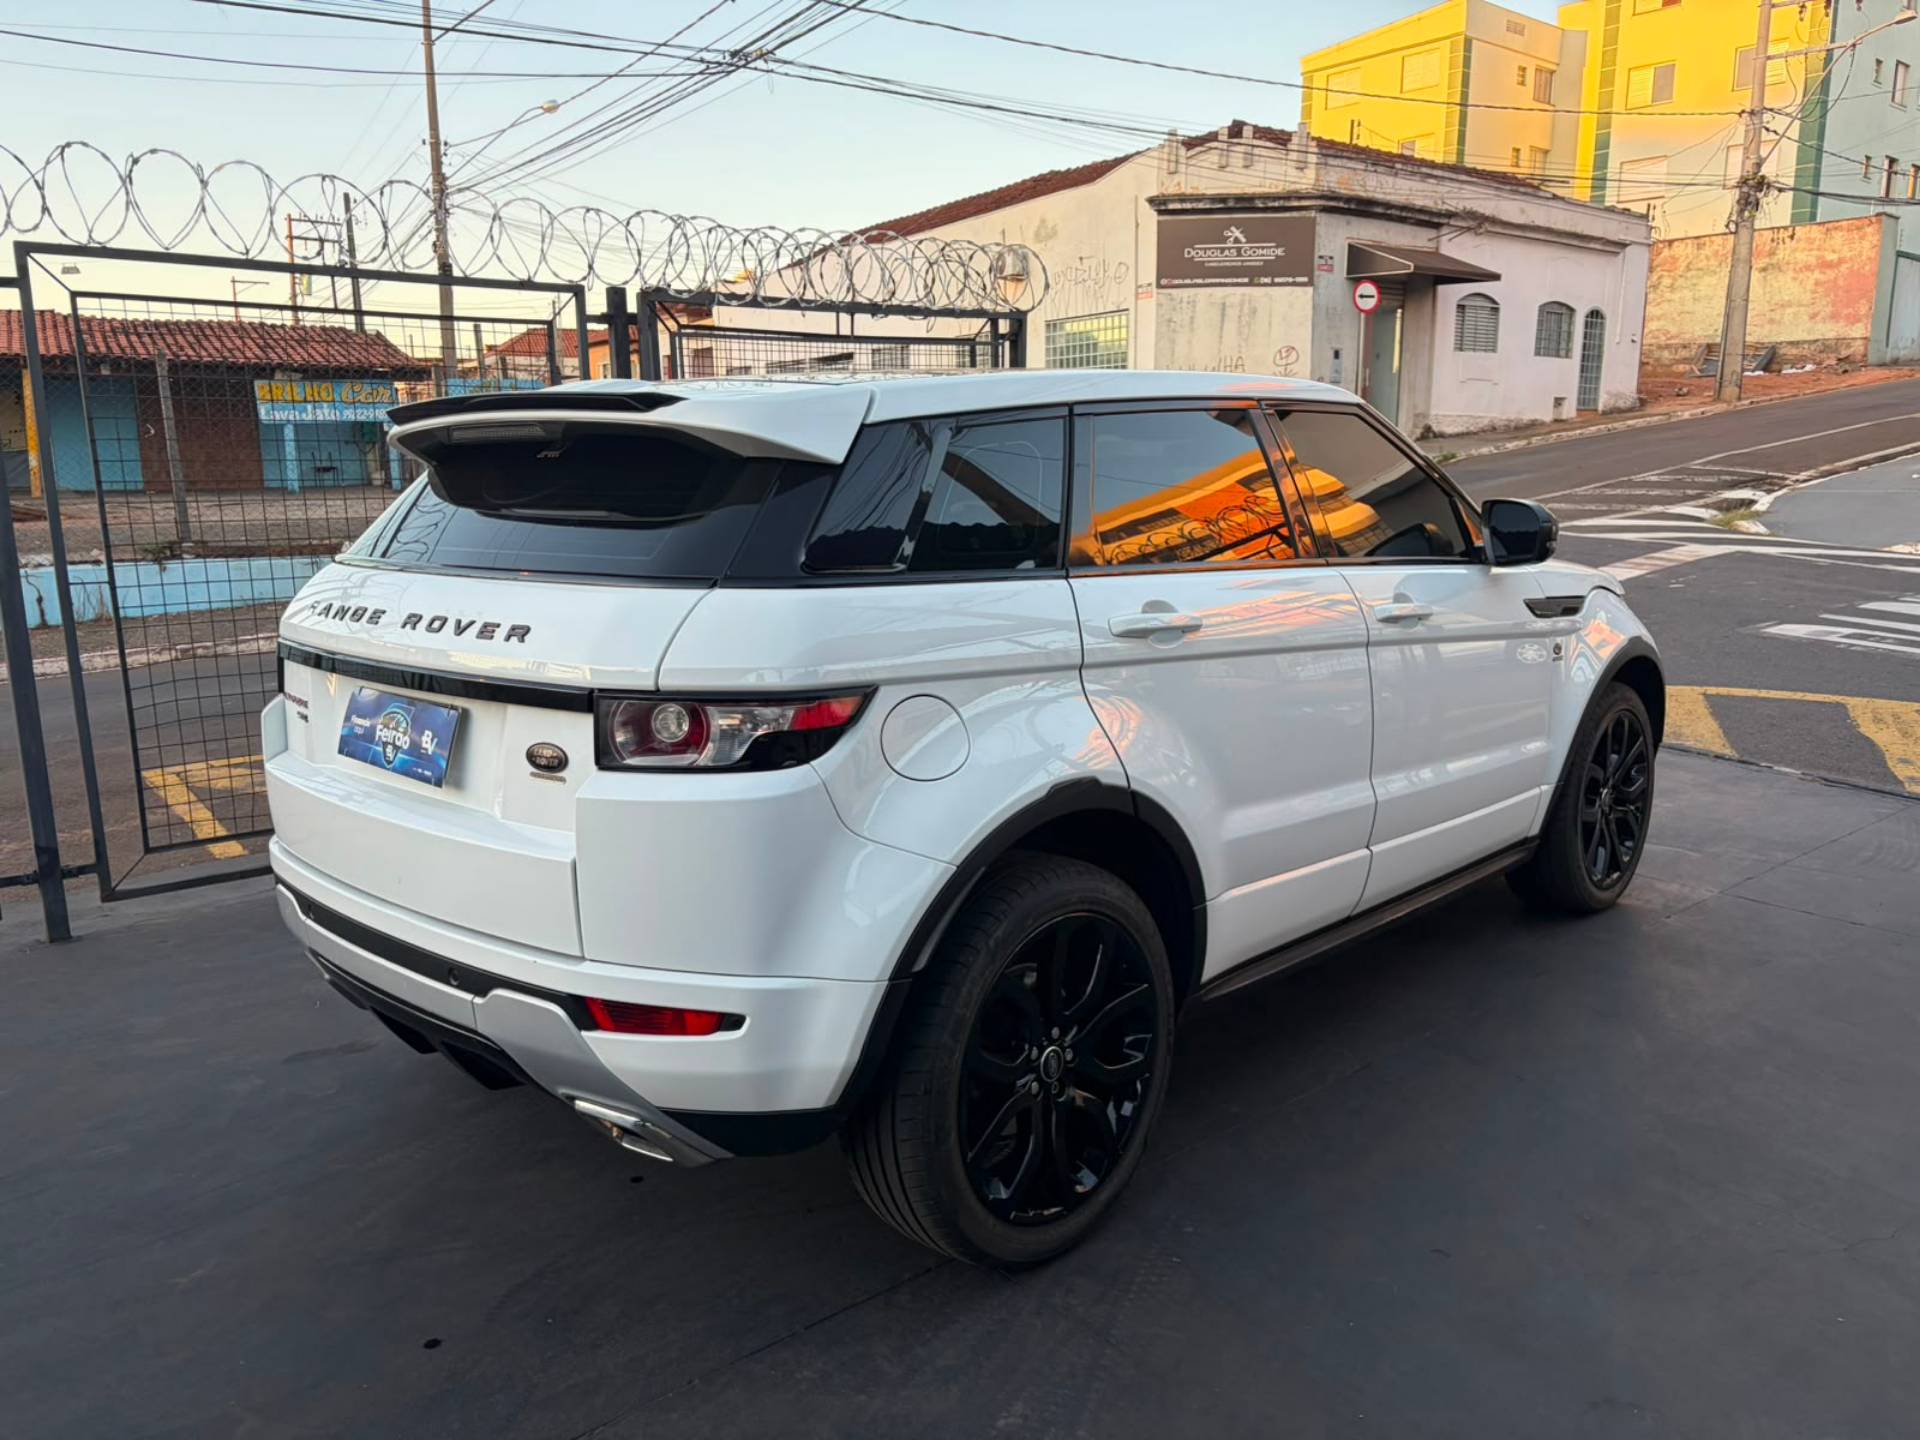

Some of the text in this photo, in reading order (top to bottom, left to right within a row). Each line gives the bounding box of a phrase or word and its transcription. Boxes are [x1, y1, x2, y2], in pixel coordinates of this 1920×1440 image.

[1184, 246, 1286, 258] DOUGLAS GOMIDE
[257, 381, 392, 404] BRILHO Car
[260, 403, 300, 421] Lava
[303, 403, 340, 422] Jato
[400, 612, 532, 644] ROVER
